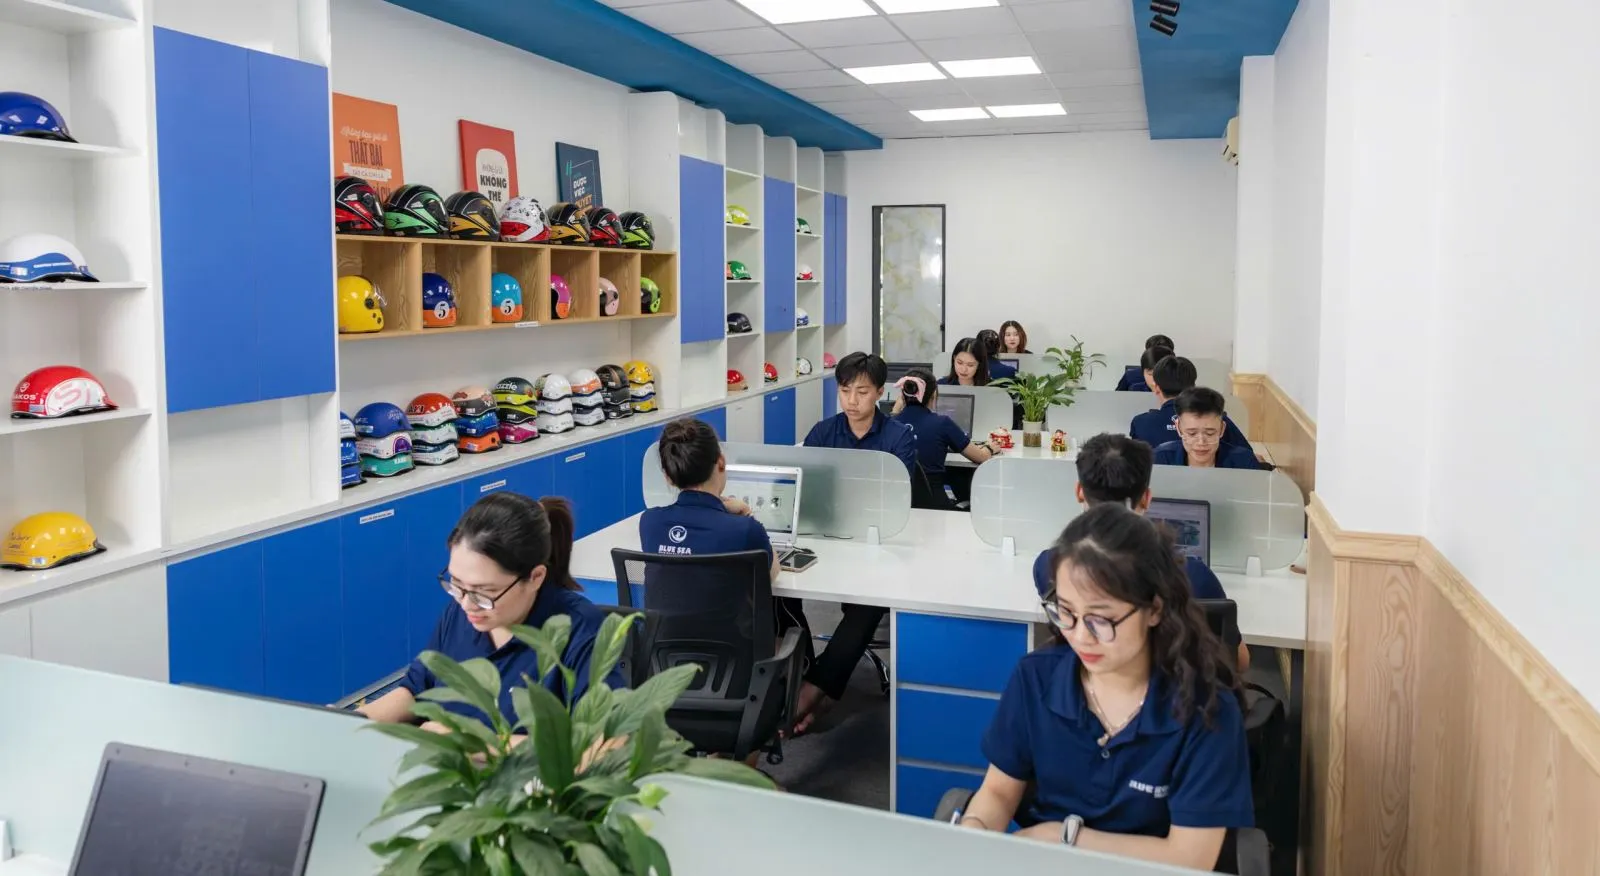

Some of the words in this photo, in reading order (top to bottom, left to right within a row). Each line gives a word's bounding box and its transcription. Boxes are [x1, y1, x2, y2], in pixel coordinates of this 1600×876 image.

[480, 173, 507, 189] KHÔNG
[438, 303, 446, 318] 5
[504, 300, 512, 314] 5
[659, 544, 676, 553] BLUE
[677, 546, 692, 555] SEA
